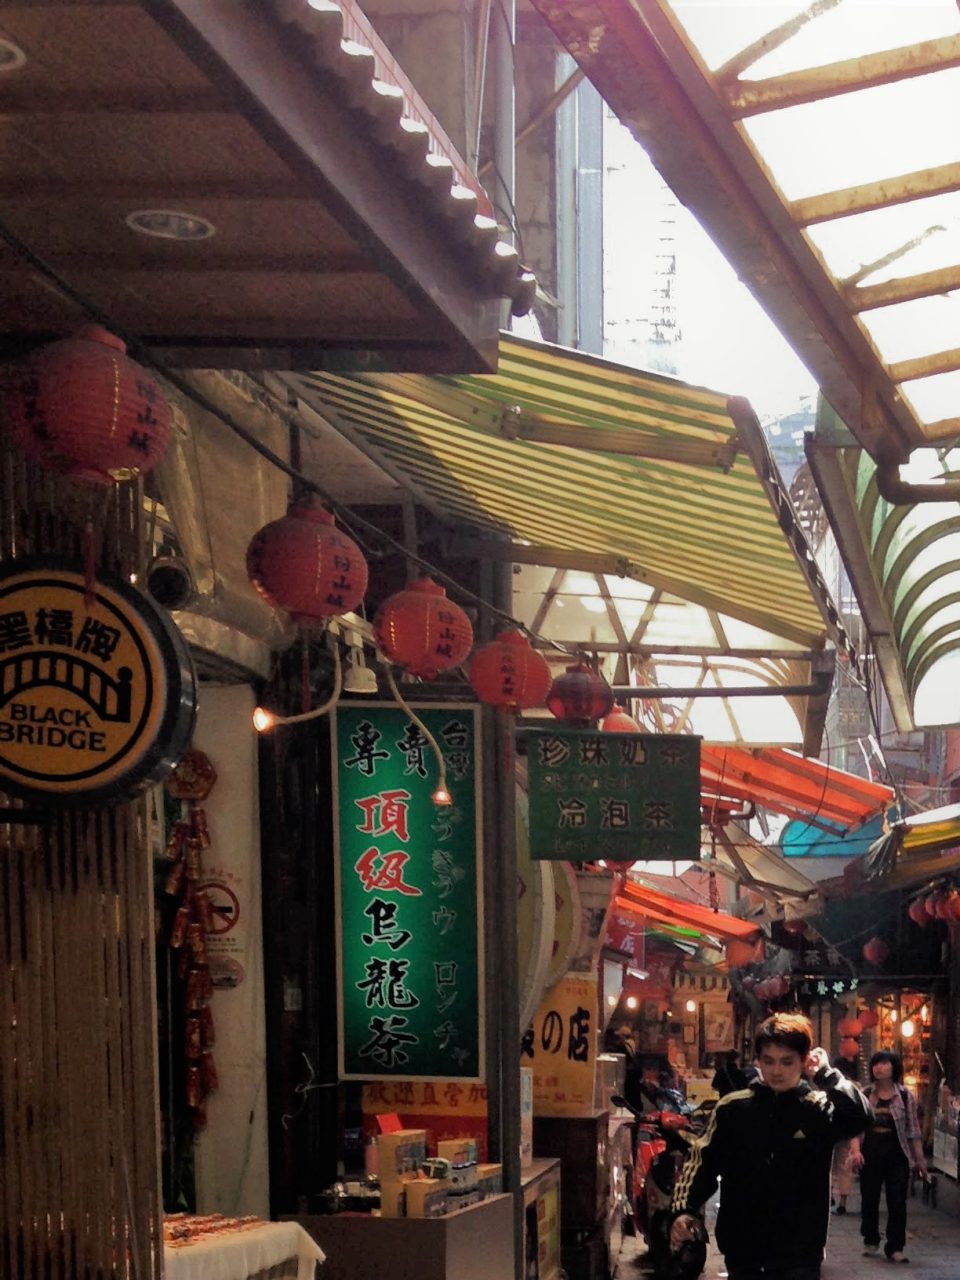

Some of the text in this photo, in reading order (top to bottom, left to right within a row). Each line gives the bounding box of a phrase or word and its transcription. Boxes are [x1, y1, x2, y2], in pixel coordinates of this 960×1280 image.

[10, 702, 92, 728] BLACK
[0, 721, 107, 752] BRIDGE
[344, 719, 428, 778] 專賣
[539, 735, 689, 766] 珍珠奶茶
[558, 797, 673, 829] 冷泡茶
[353, 787, 425, 1069] 頂級烏龍茶
